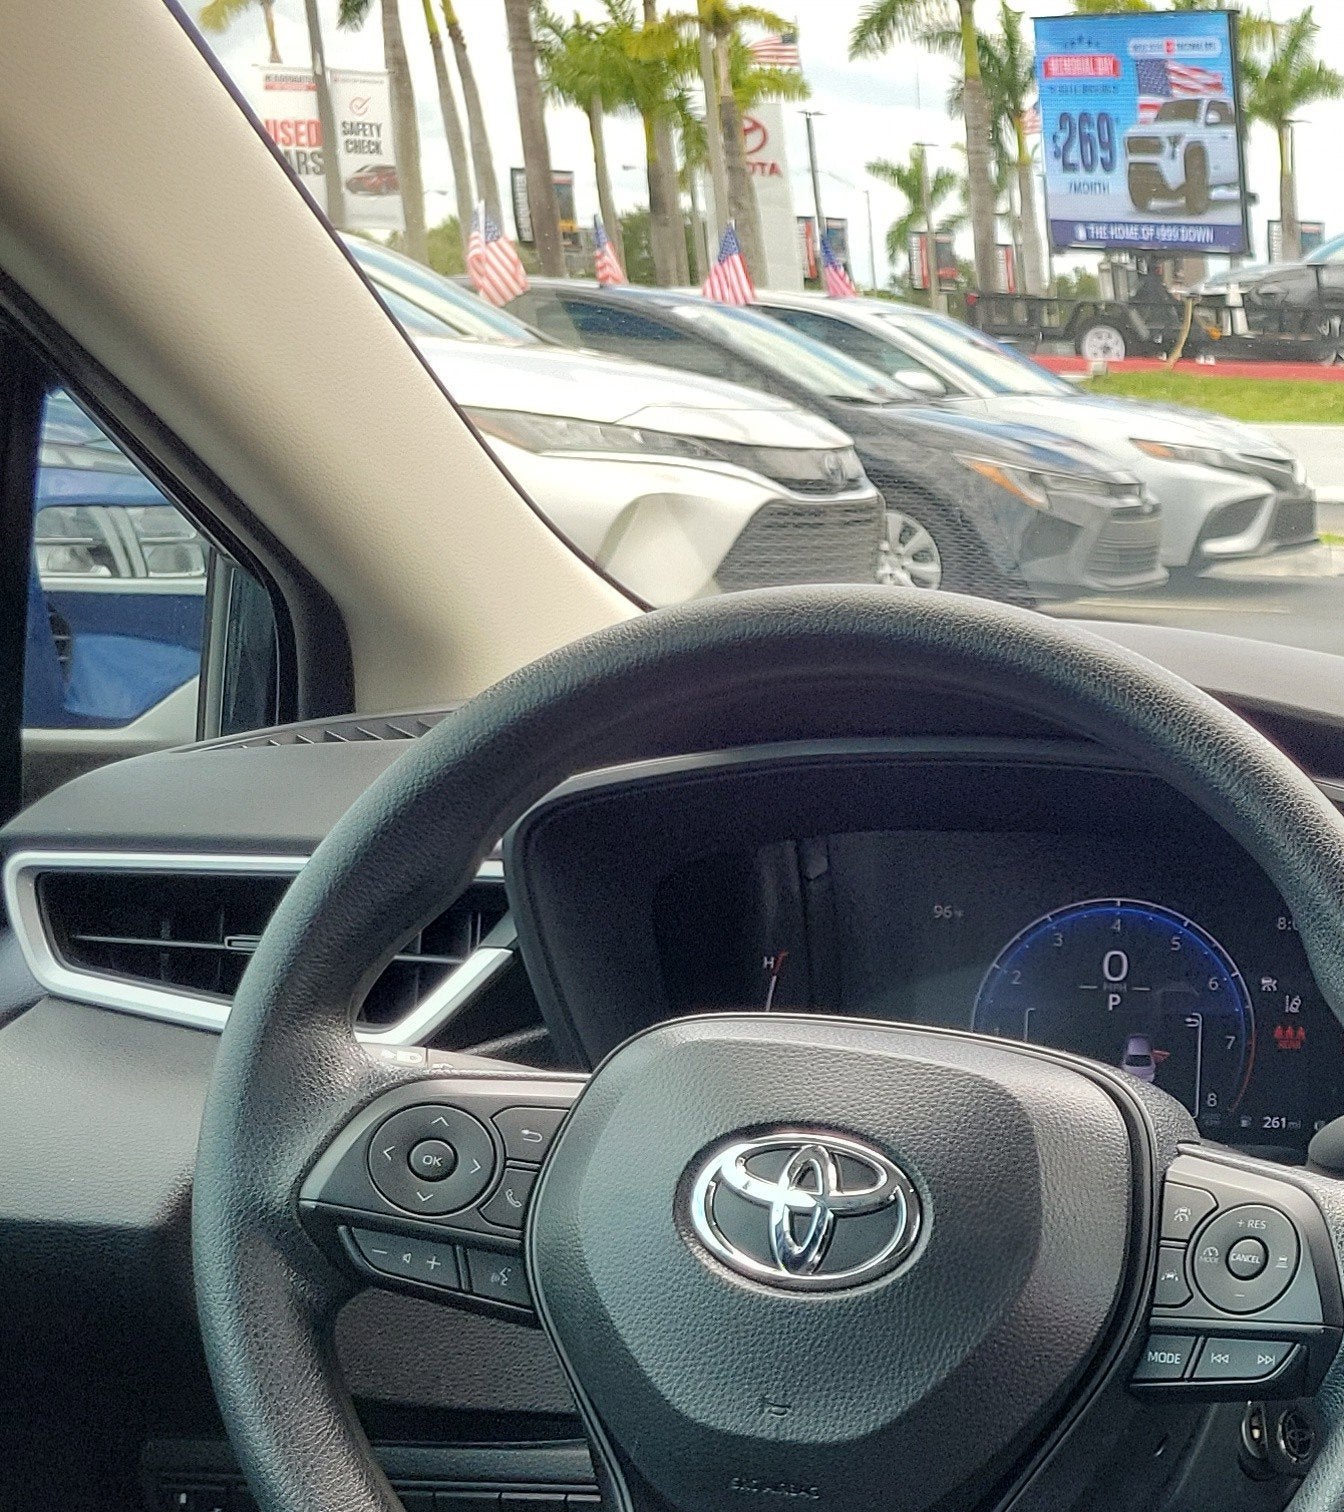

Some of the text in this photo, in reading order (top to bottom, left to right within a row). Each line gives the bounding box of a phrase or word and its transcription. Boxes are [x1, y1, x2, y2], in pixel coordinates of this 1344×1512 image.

[265, 119, 323, 147] USED
[341, 121, 383, 138] SAFETY
[344, 138, 382, 155] CHECK
[284, 150, 325, 175] ARS
[1112, 919, 1122, 932] 4
[1053, 933, 1064, 947] 3
[1170, 936, 1182, 951] 5
[763, 956, 775, 969] H
[1103, 950, 1129, 982] 0
[1011, 969, 1022, 985] 2
[1208, 977, 1219, 991] 6
[1108, 993, 1121, 1011] P
[1225, 1035, 1236, 1050] 7
[1206, 1092, 1218, 1107] 8
[1262, 1116, 1286, 1129] 261
[422, 1155, 443, 1167] OK
[1247, 1219, 1267, 1230] RES
[1230, 1252, 1262, 1265] CANCEL
[1148, 1350, 1181, 1365] MODE
